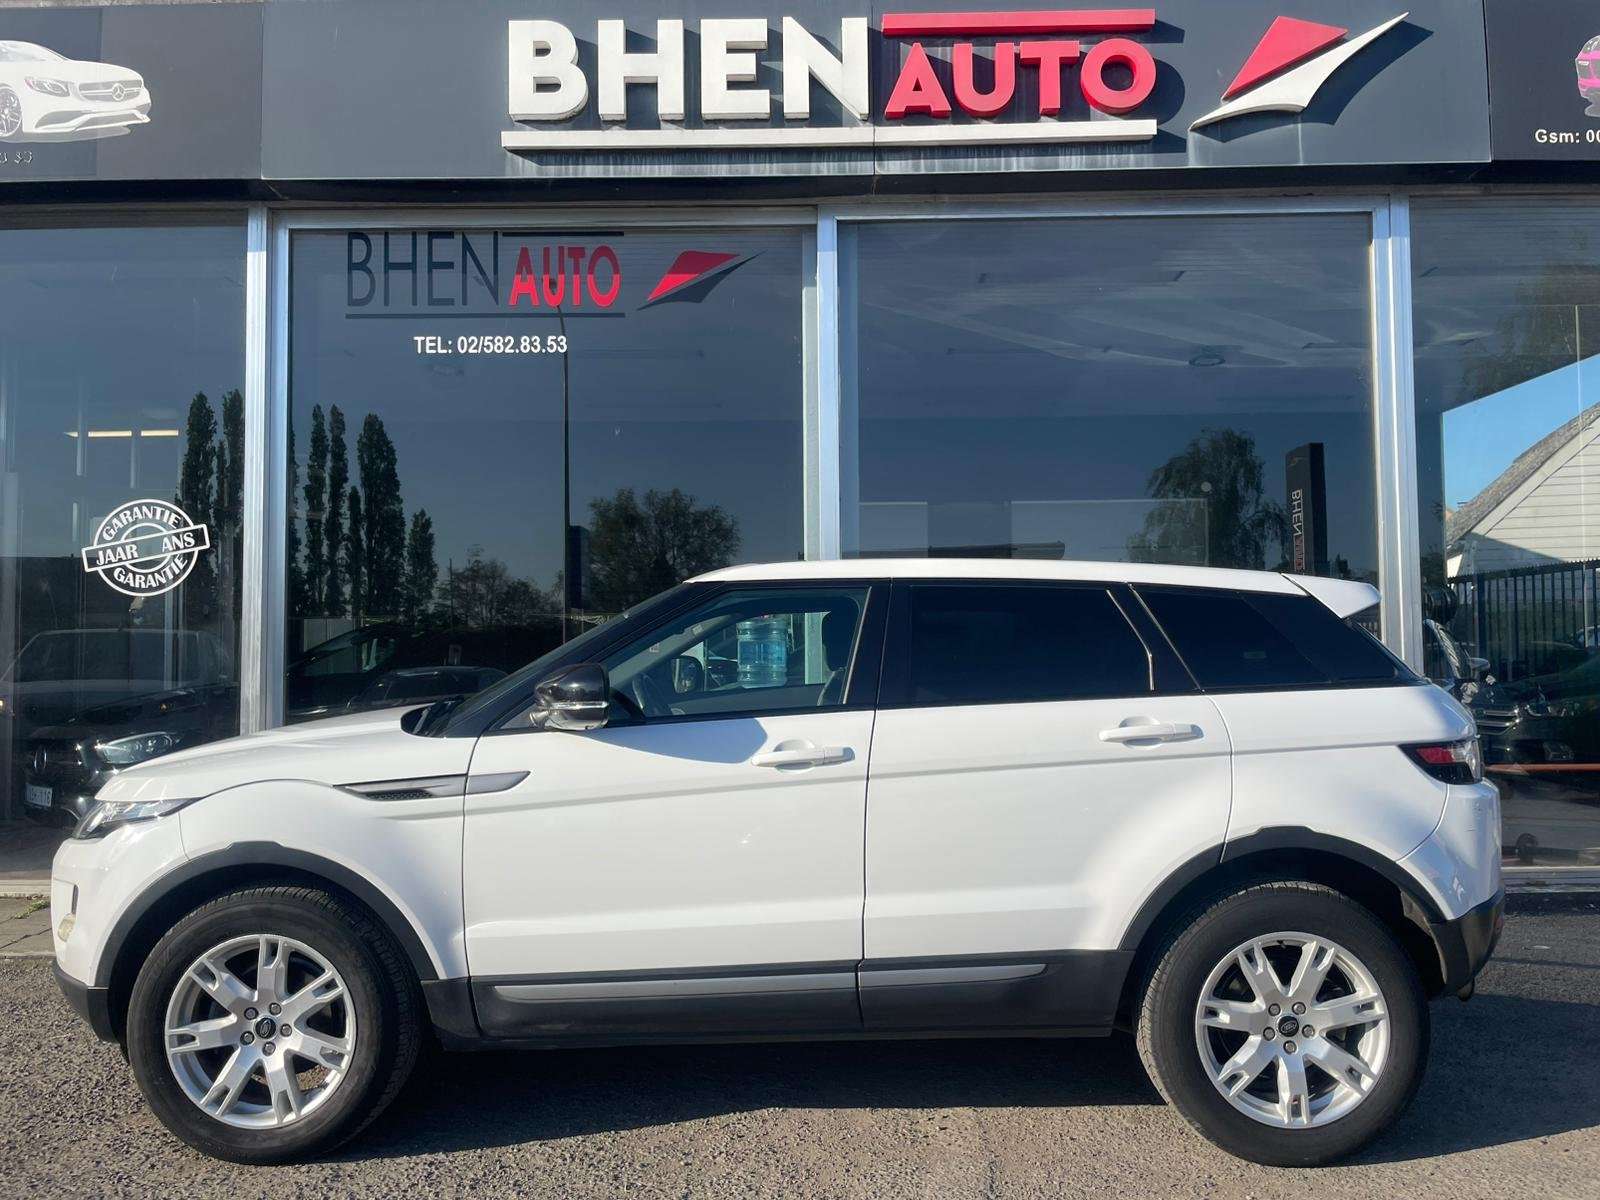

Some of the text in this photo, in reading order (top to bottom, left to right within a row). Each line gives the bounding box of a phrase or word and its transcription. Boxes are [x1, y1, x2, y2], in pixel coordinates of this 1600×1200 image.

[507, 16, 1157, 121] BHEN AUTO
[1535, 129, 1580, 143] Gsm:
[347, 231, 622, 307] BHEN AUTO
[413, 335, 568, 354] TEL: 02/582.83.53
[102, 505, 181, 541] GARANTIE
[96, 532, 196, 566] JAAR ANS
[113, 554, 188, 589] GARANTIE
